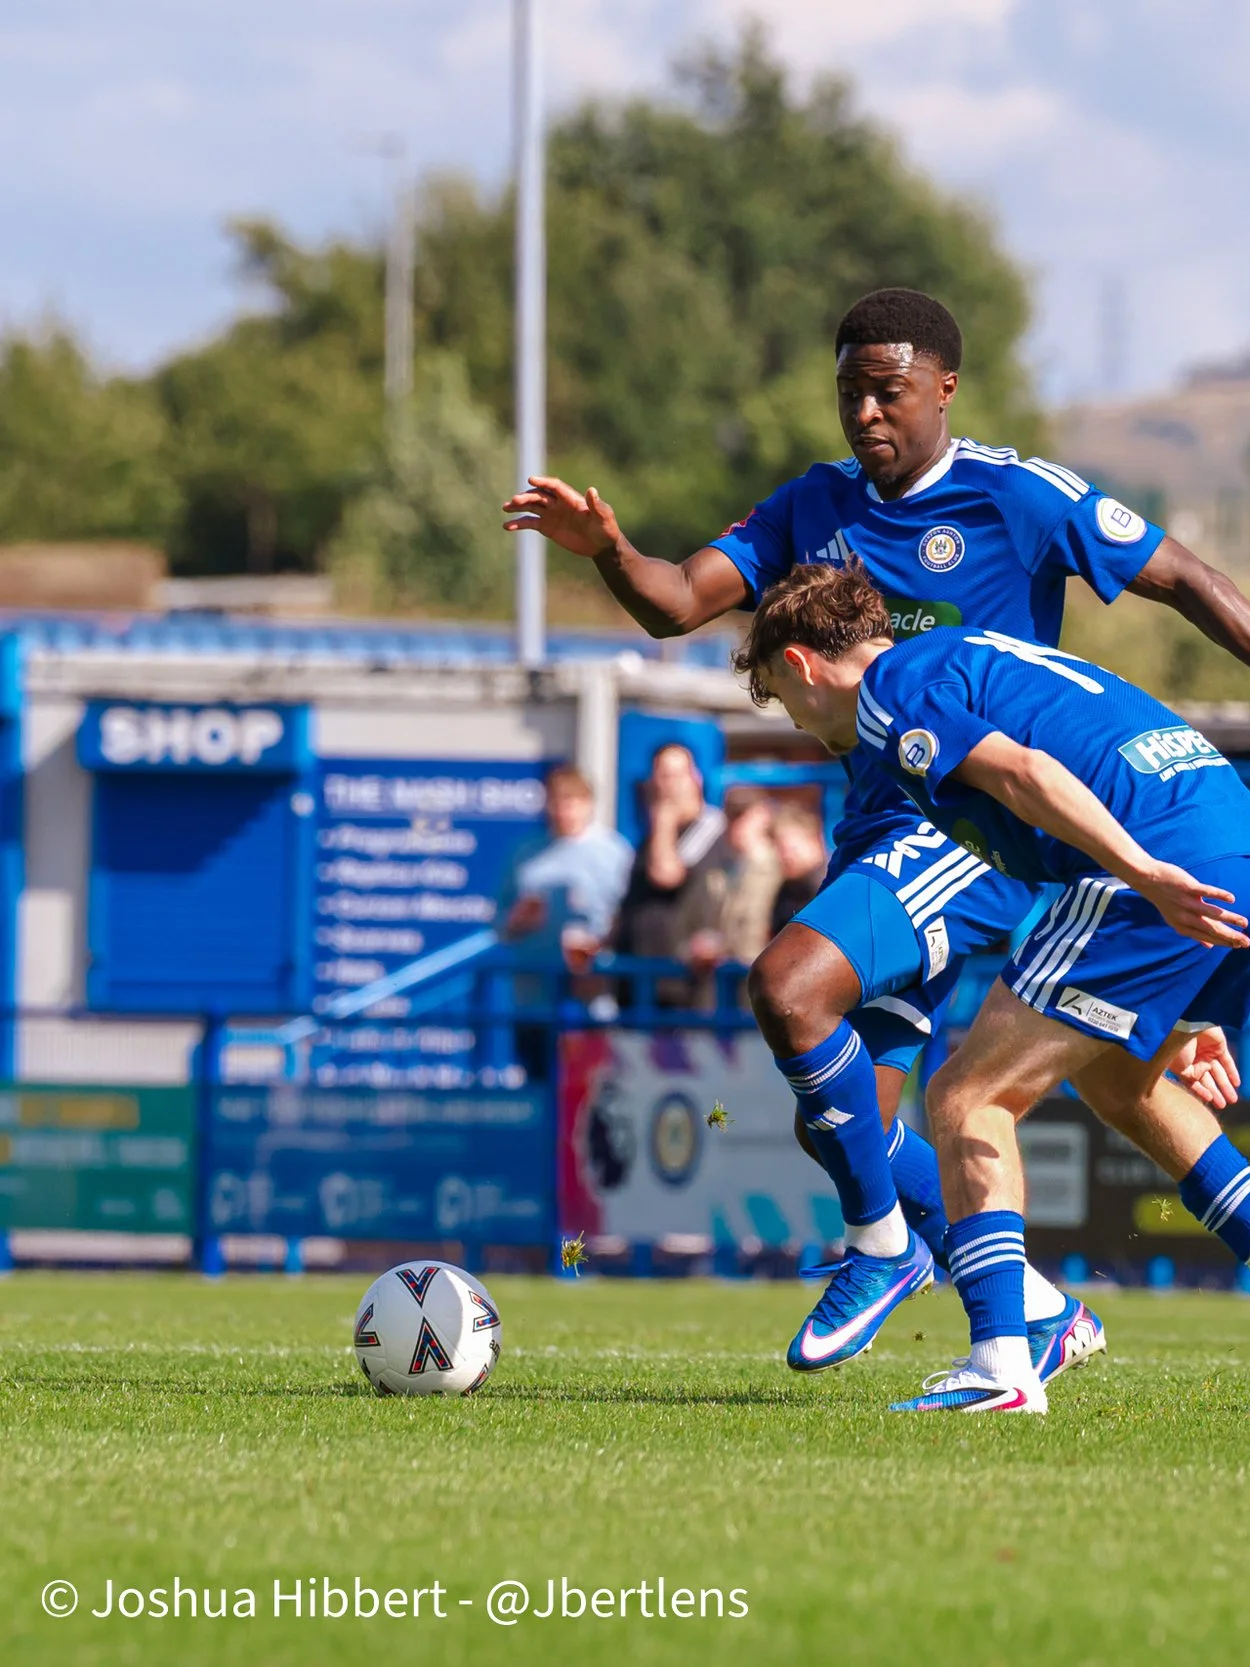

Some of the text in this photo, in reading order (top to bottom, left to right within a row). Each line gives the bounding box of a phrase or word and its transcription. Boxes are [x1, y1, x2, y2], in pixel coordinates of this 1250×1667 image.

[1110, 507, 1132, 528] B
[890, 608, 936, 632] acle
[99, 706, 285, 765] SHOP
[1092, 1007, 1118, 1022] AZTEK
